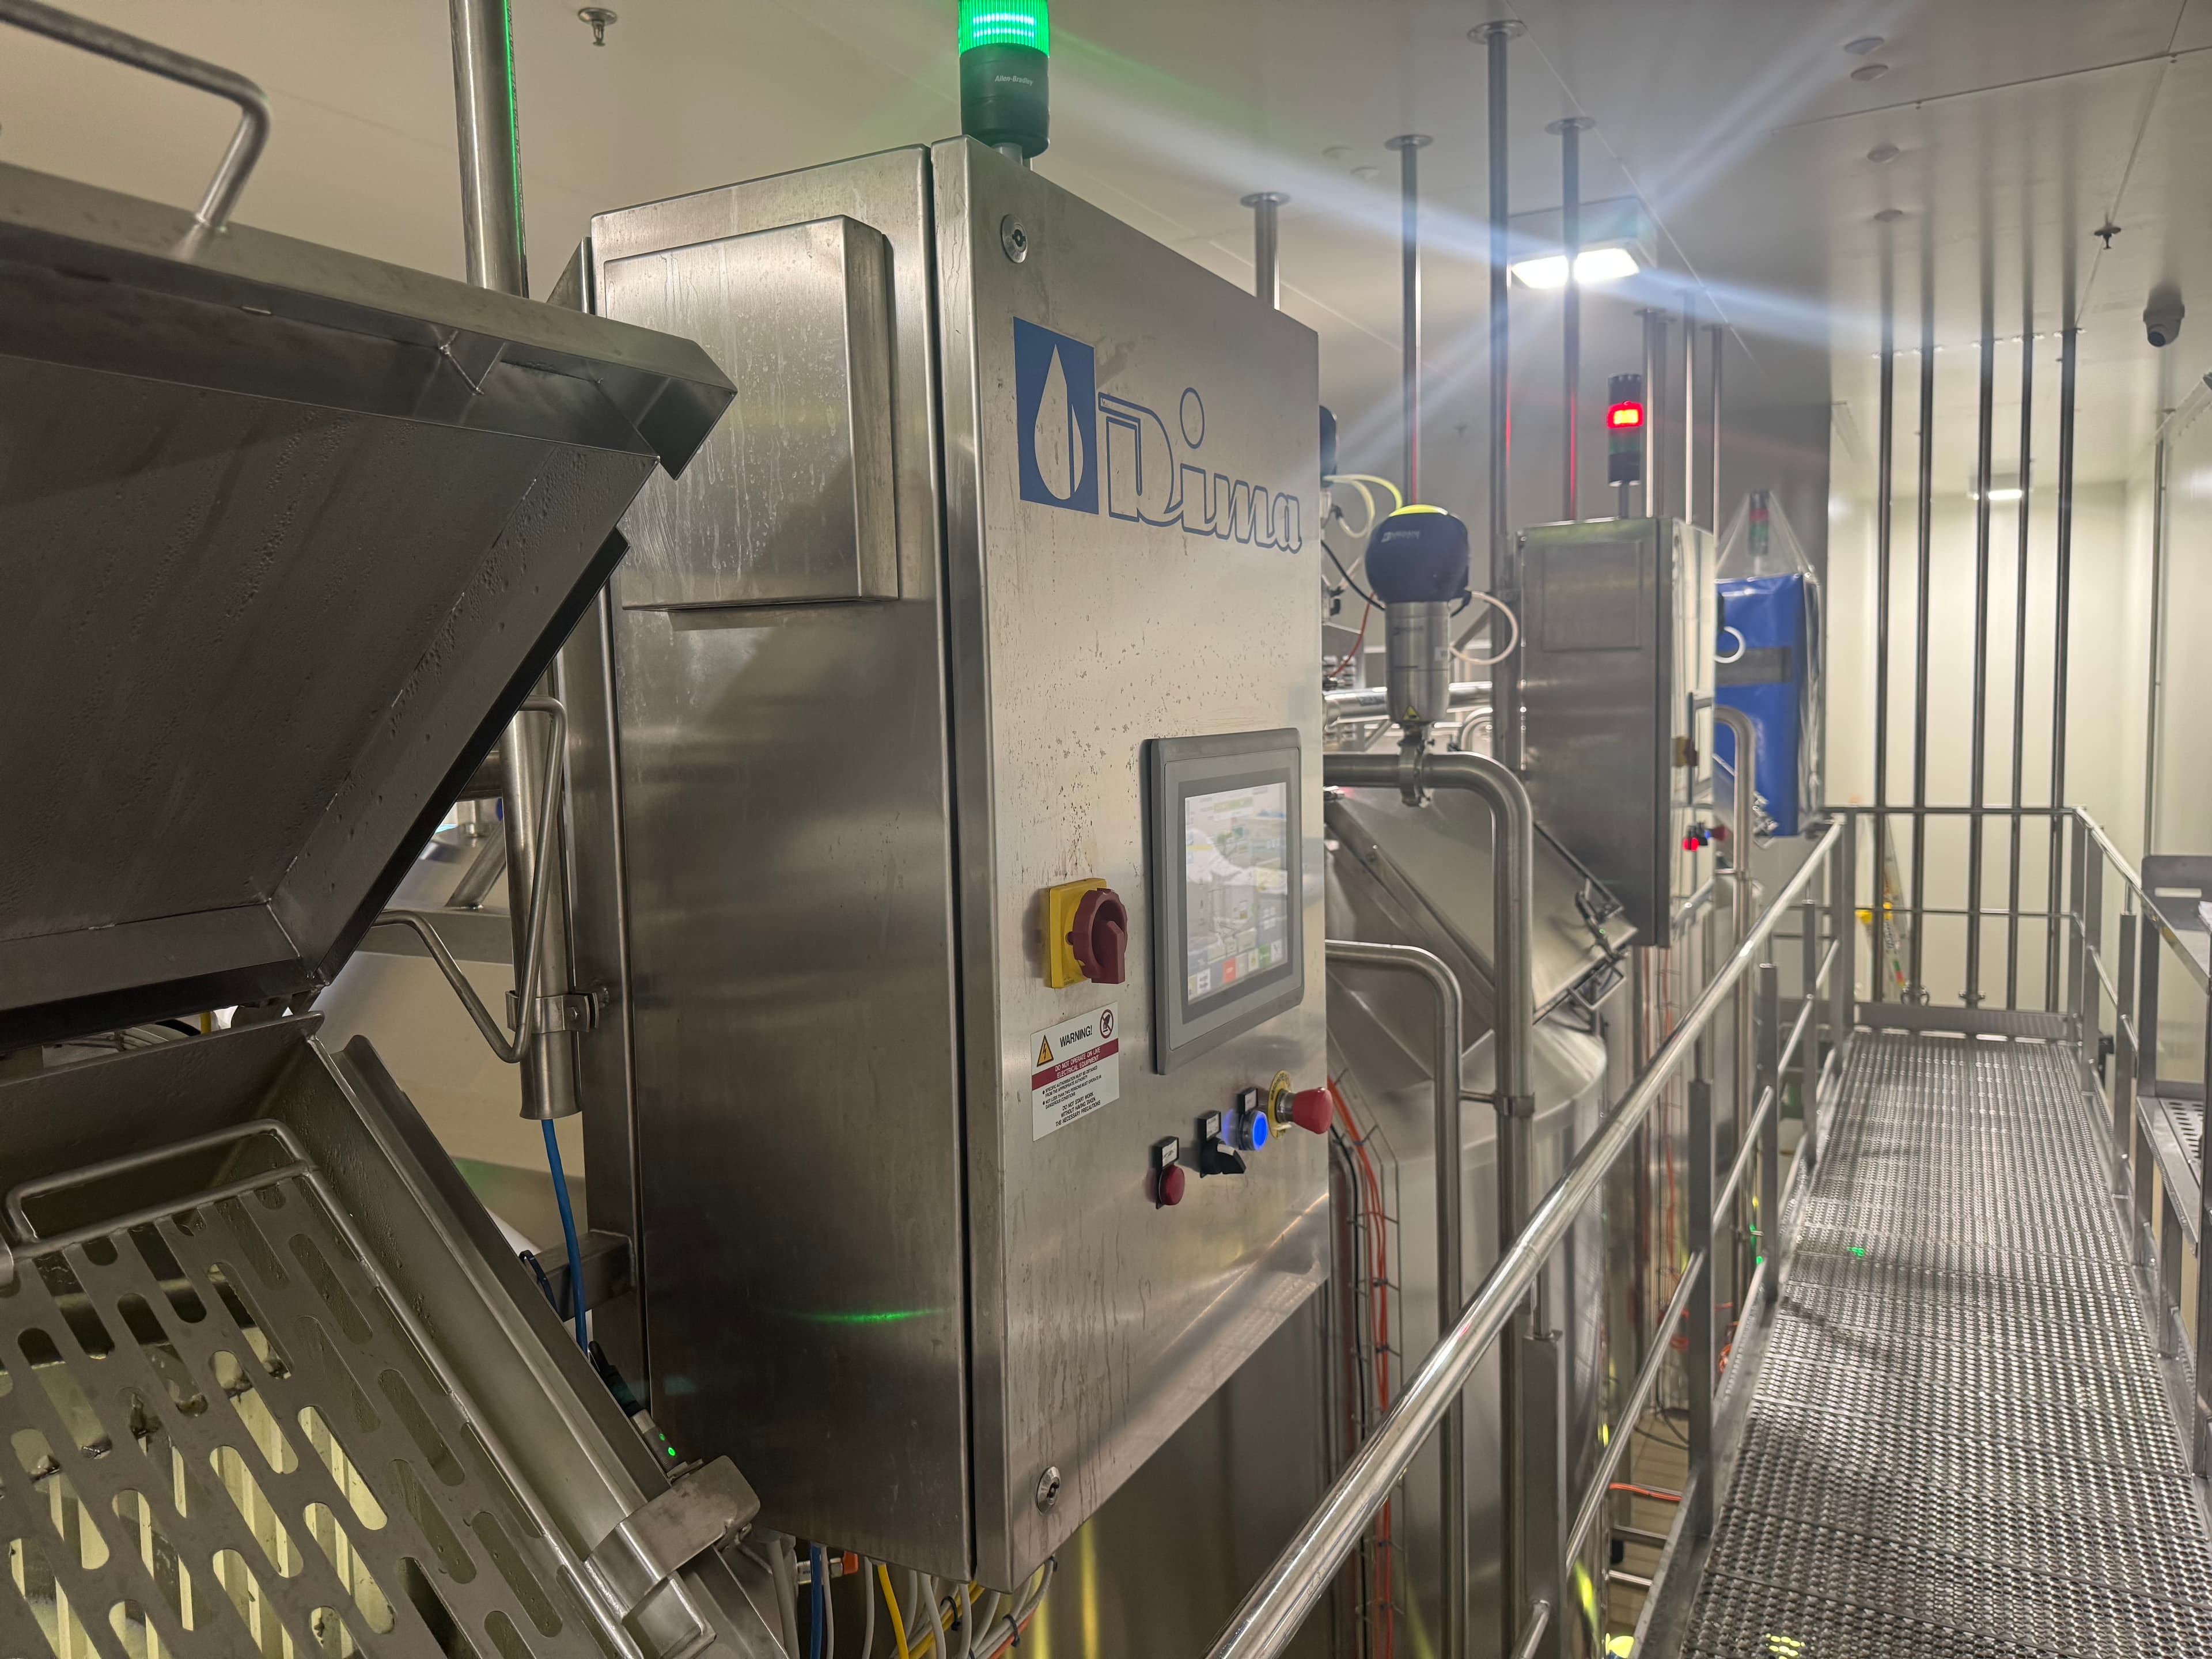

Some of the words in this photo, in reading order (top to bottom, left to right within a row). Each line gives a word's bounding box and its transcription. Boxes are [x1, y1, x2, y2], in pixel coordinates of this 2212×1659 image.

[995, 75, 1033, 86] Allen-Bradley
[1098, 387, 1302, 554] Dima
[1060, 1025, 1092, 1047] WARNING!
[1056, 1065, 1078, 1078] ELECTRICAL
[1079, 1055, 1099, 1068] EQUIPMENT
[1061, 1060, 1069, 1069] NOT
[1070, 1054, 1086, 1065] OPERATE
[1092, 1047, 1100, 1055] LIVE
[1074, 1075, 1088, 1084] AUTHORITY
[1060, 1108, 1074, 1117] WITHOUT
[1074, 1102, 1086, 1110] HAVING
[1062, 1111, 1080, 1123] NECESSARY
[1080, 1100, 1100, 1113] PRECAUTIONS
